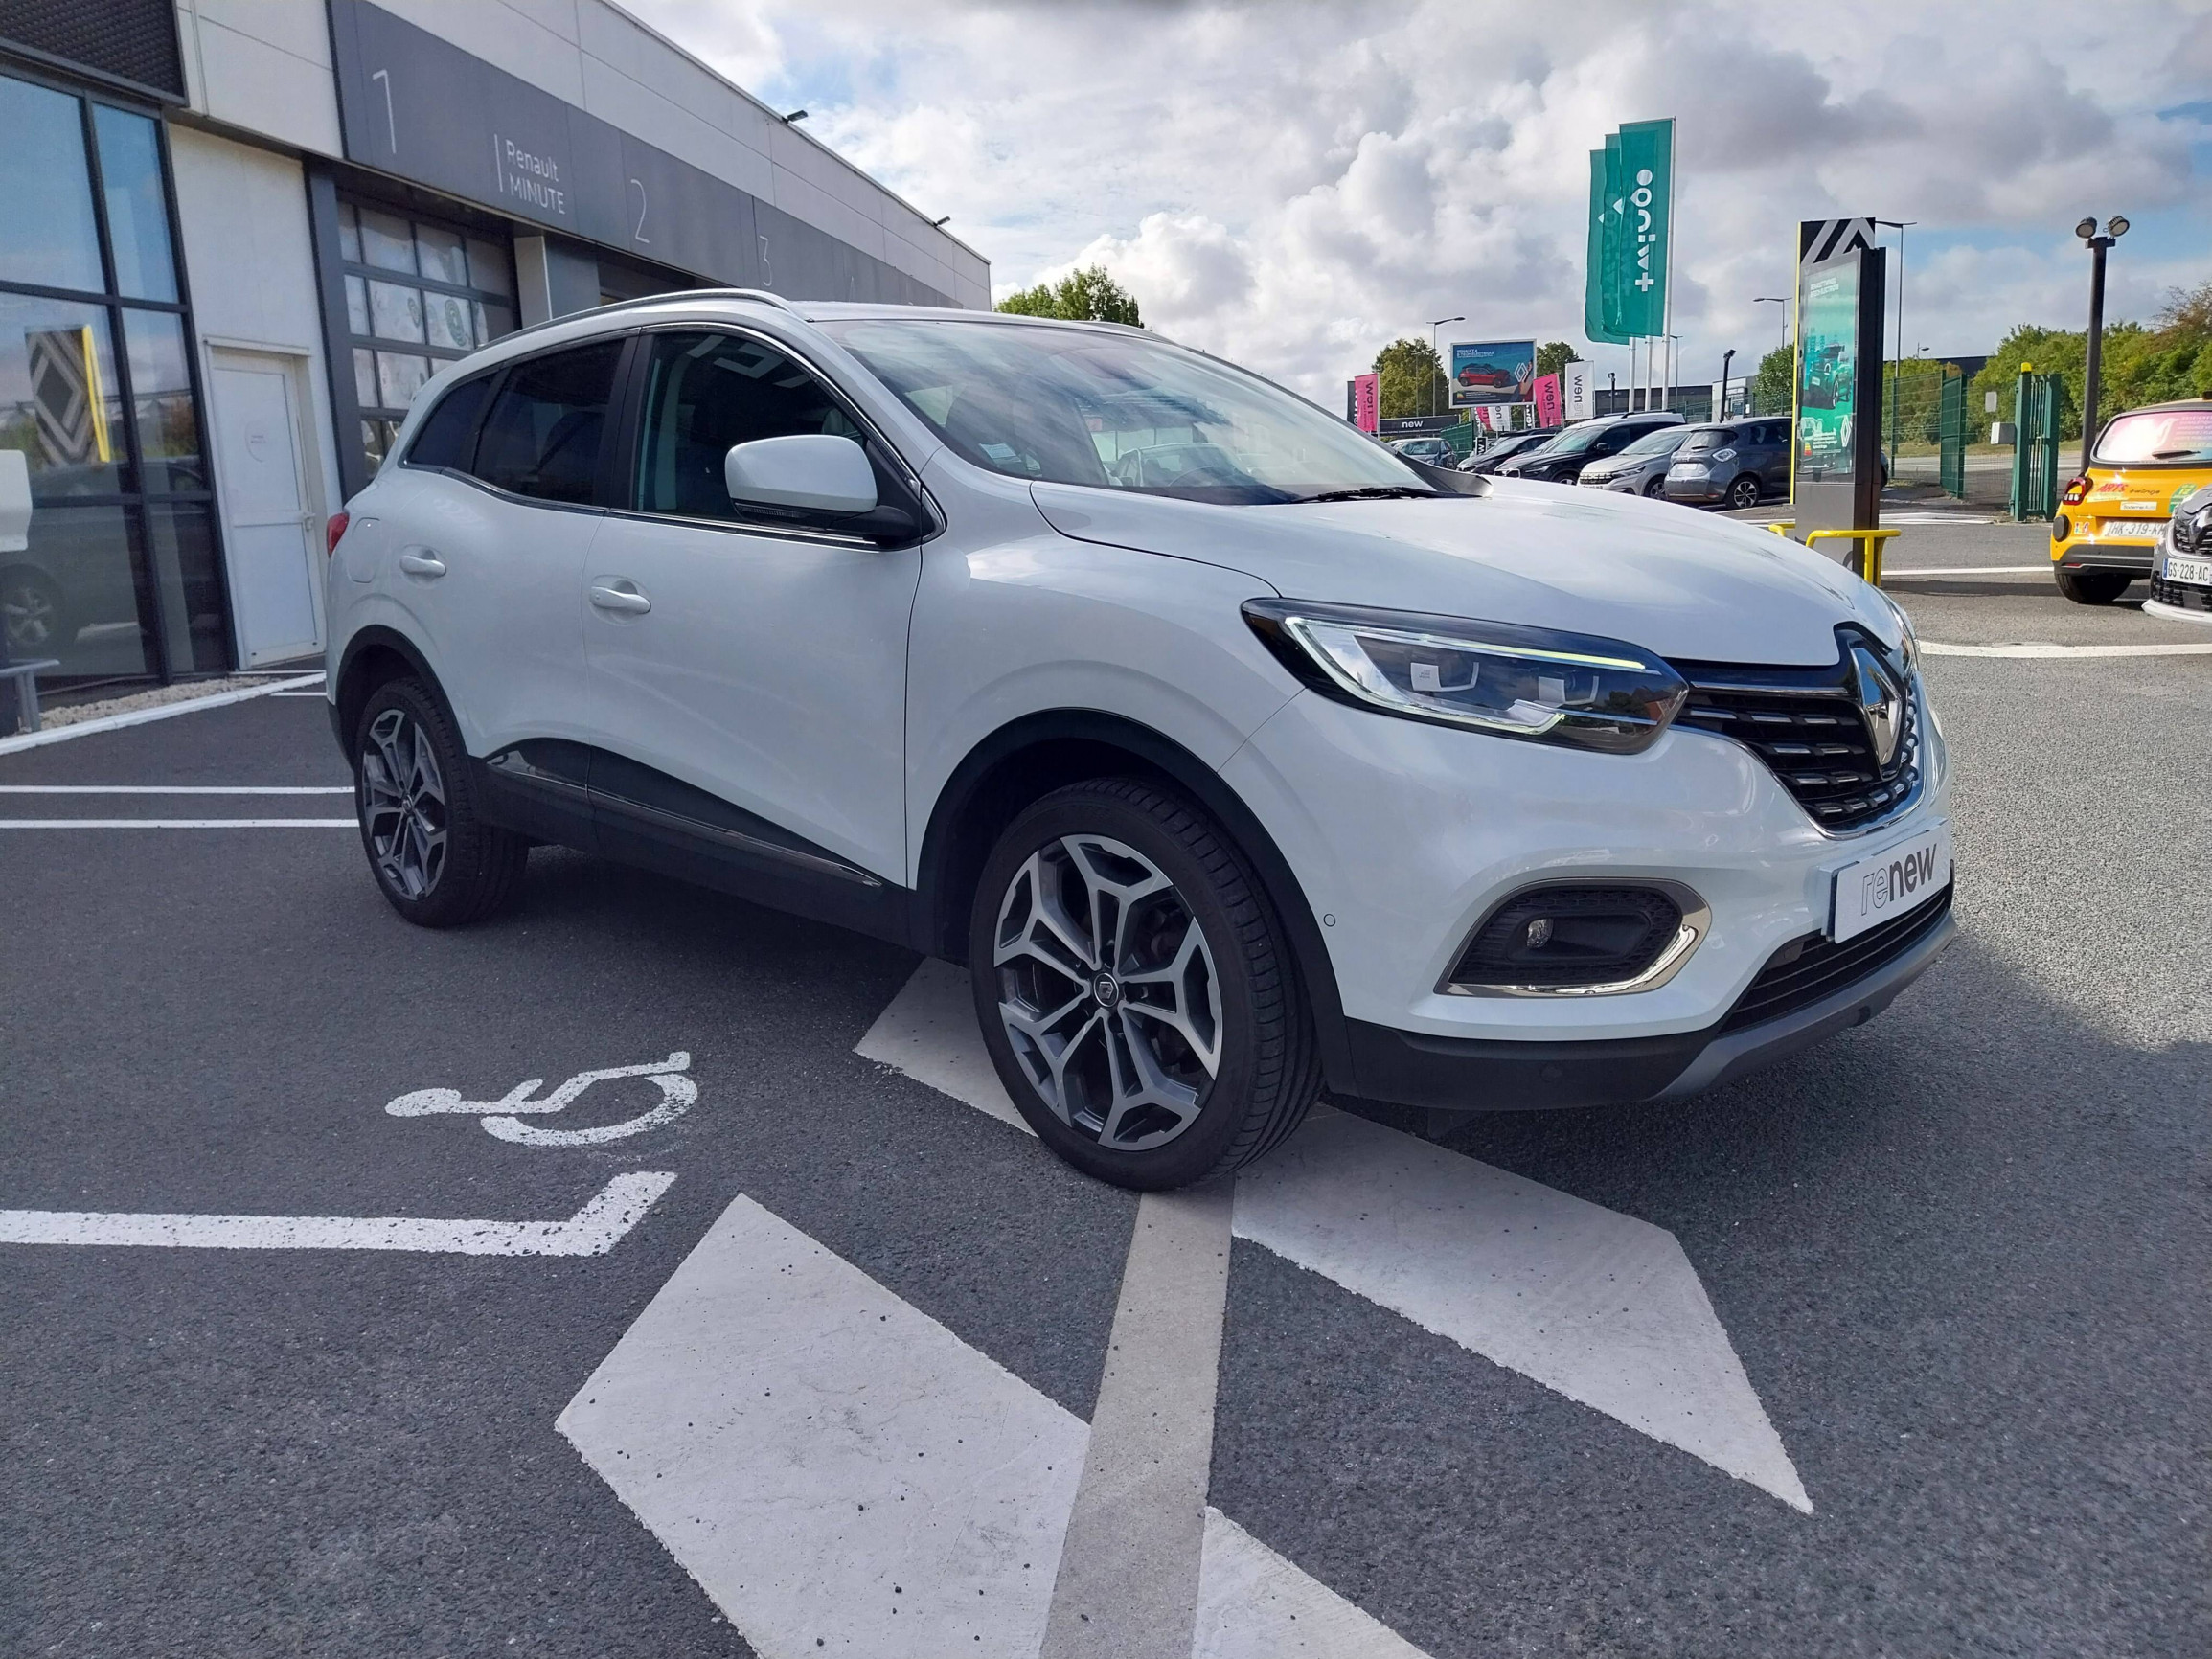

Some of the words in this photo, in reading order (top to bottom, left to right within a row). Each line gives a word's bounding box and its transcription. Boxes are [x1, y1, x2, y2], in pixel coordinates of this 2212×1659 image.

[372, 68, 398, 154] 1
[506, 140, 559, 183] Renault
[509, 176, 566, 216] MINUTE
[629, 178, 650, 244] 2
[759, 235, 773, 287] 3
[2168, 561, 2209, 582] GS-228-AC
[1860, 843, 1937, 917] renew
